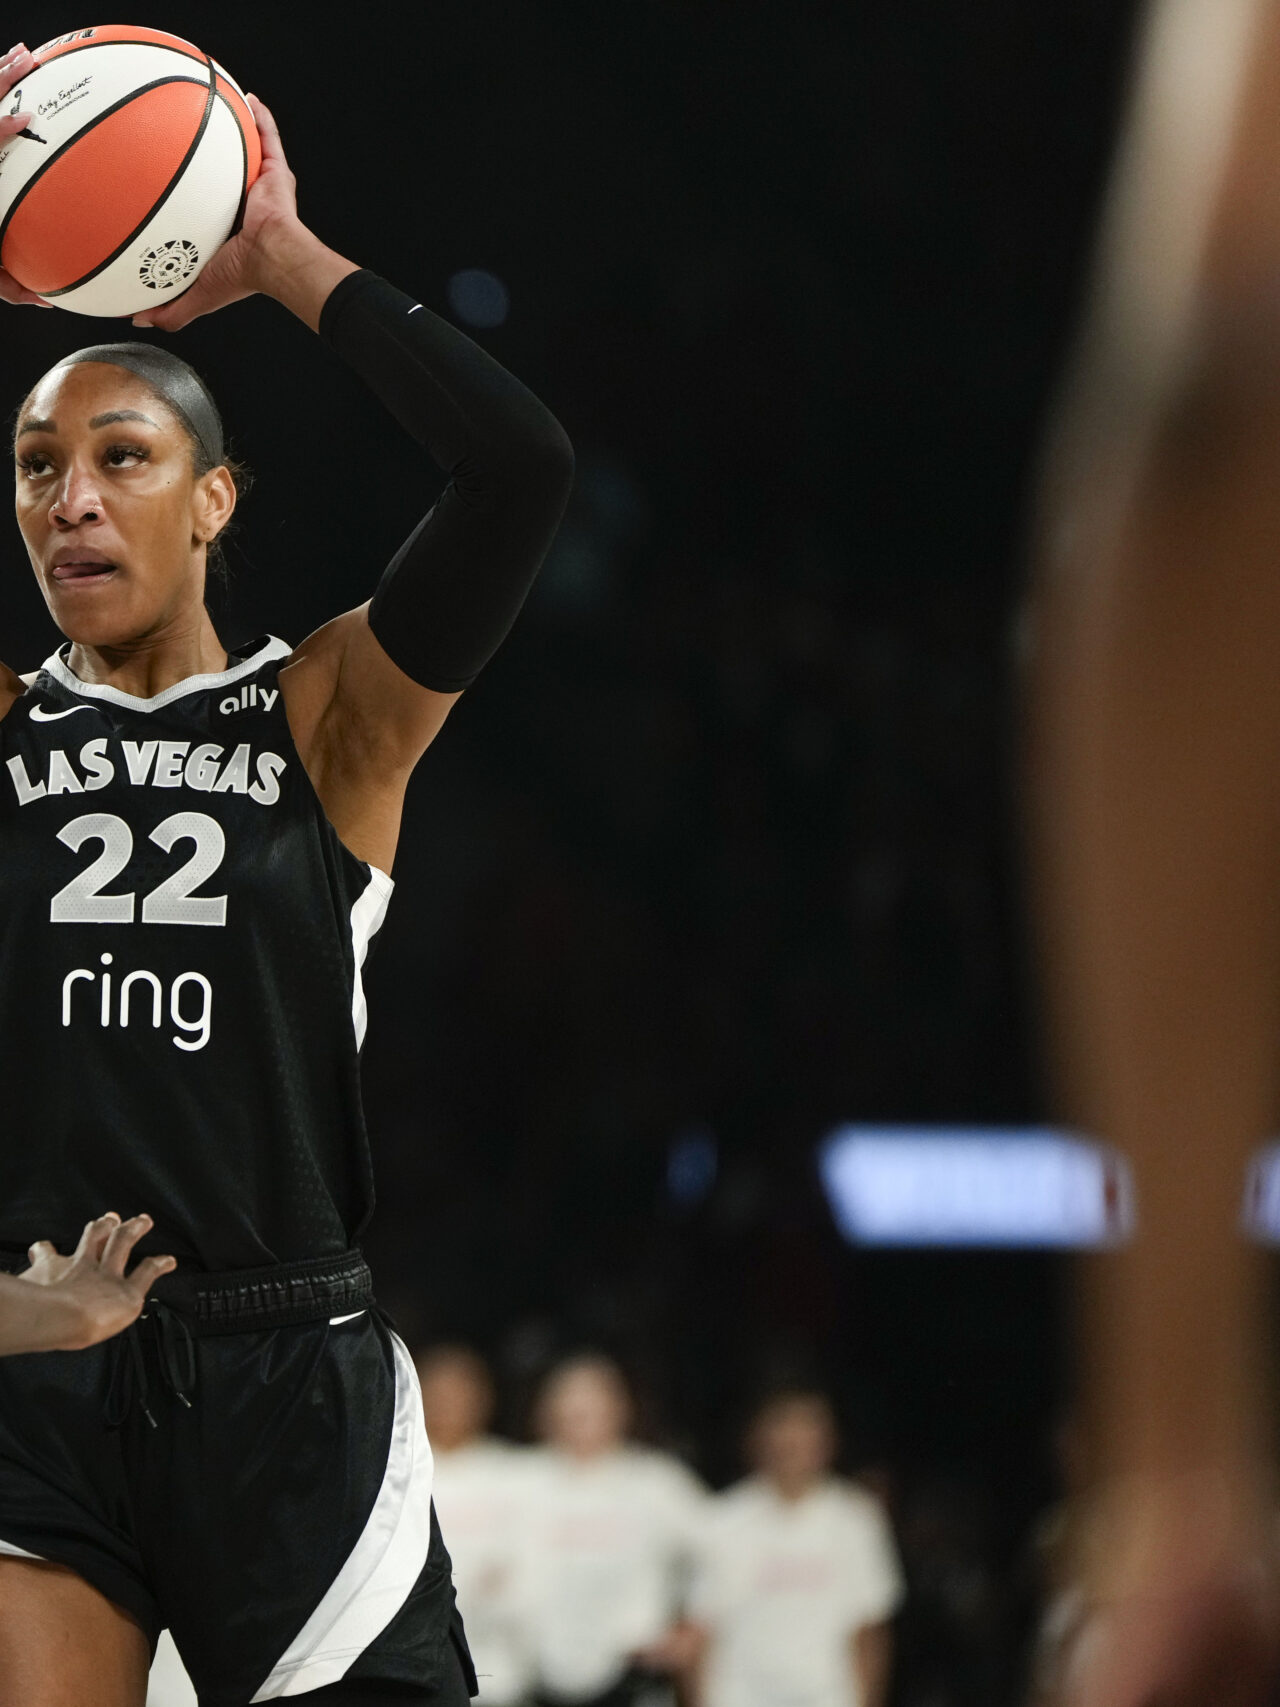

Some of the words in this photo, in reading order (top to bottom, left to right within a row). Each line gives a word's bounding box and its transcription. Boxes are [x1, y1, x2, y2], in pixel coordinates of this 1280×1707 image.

[219, 684, 279, 715] ally
[6, 738, 115, 806] LAS
[121, 740, 287, 806] VEGAS
[50, 811, 228, 927] 22
[62, 952, 212, 1052] ring
